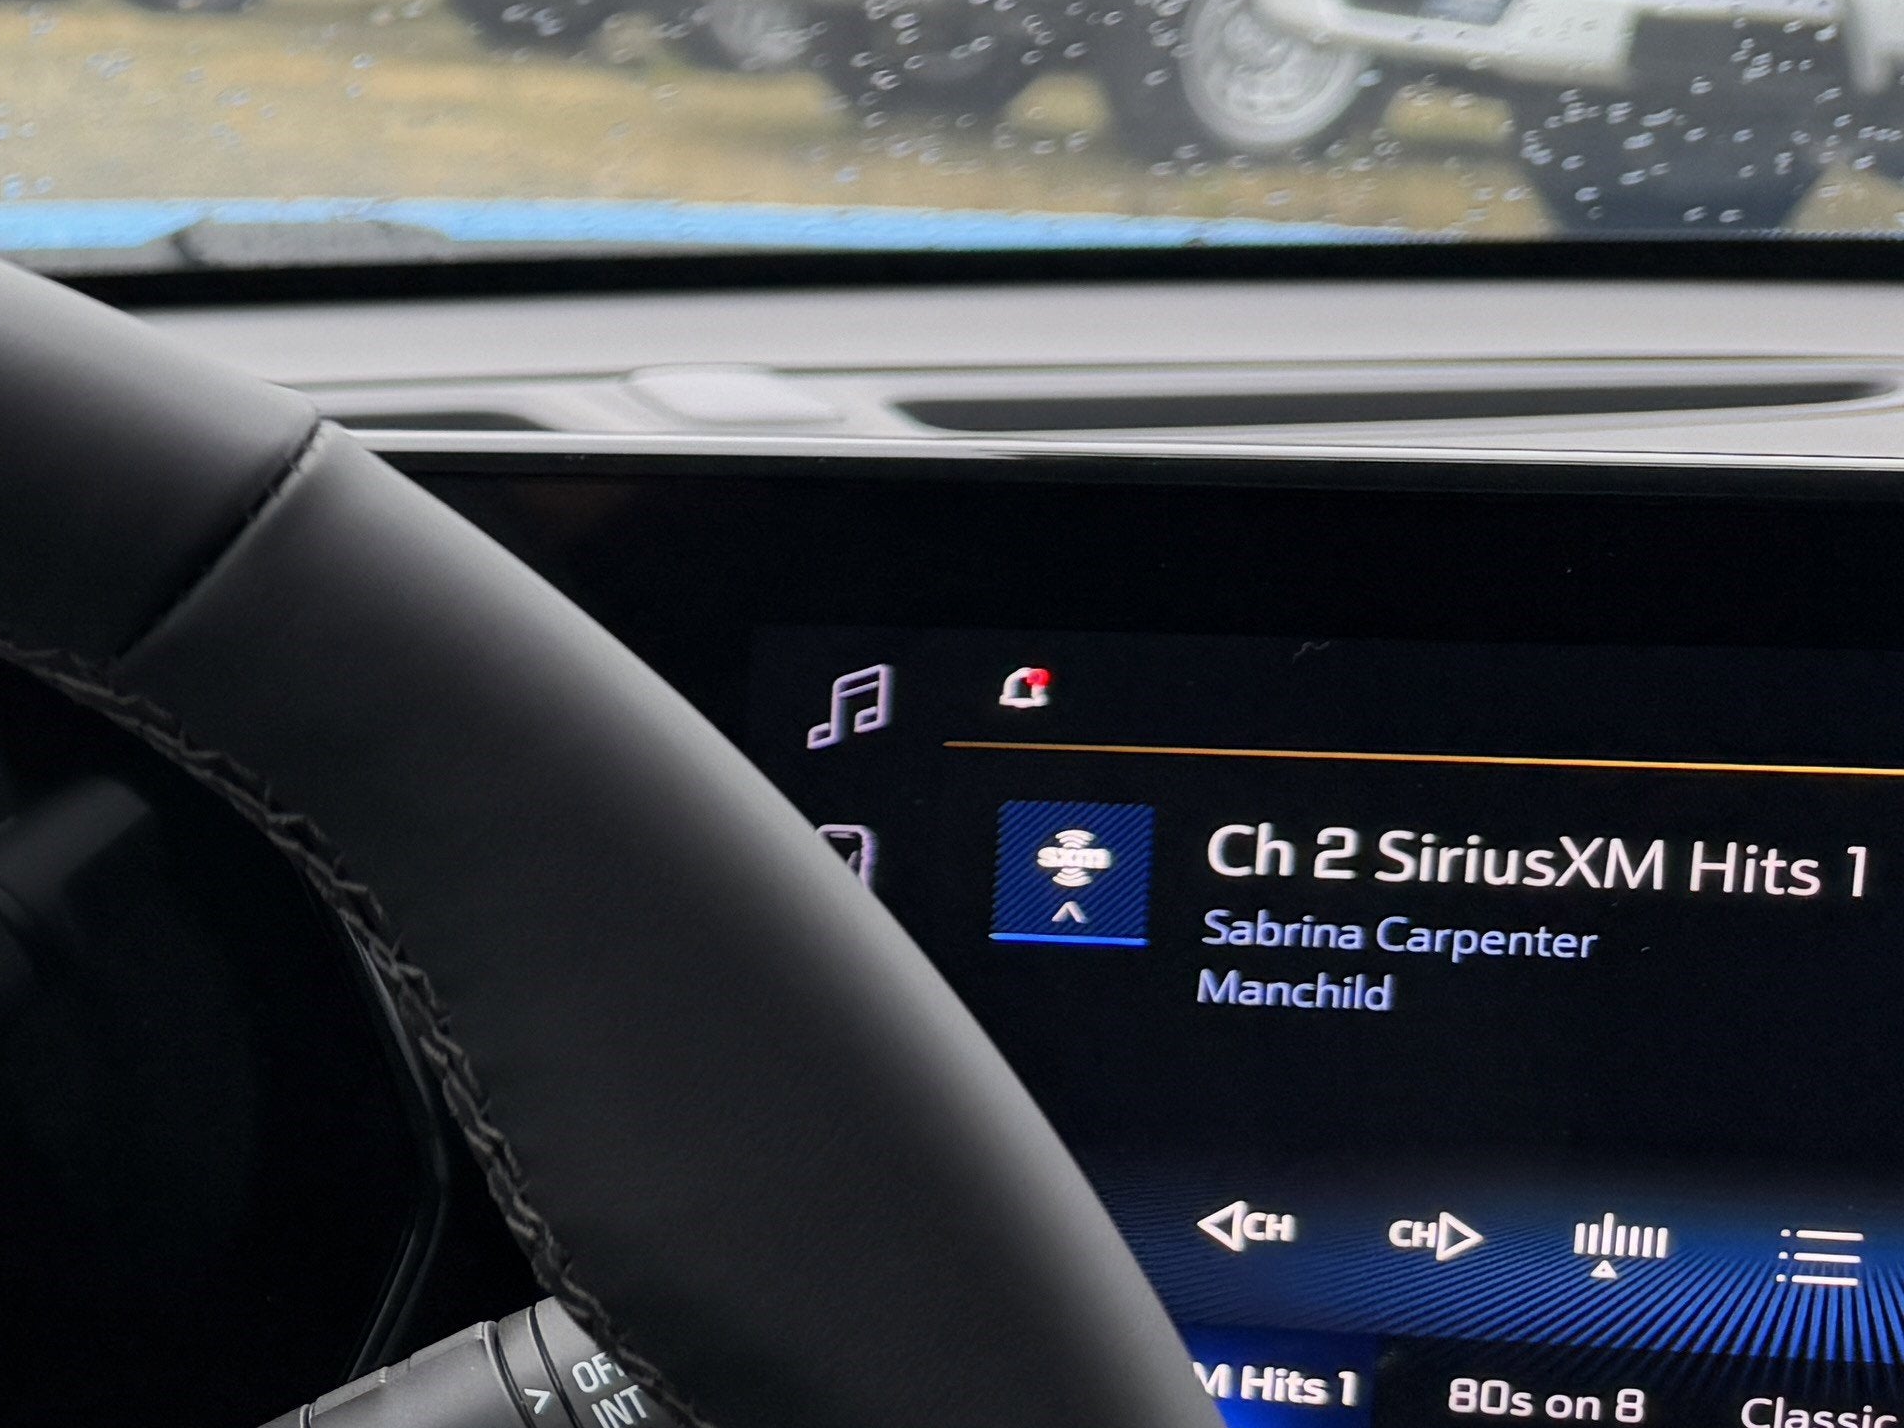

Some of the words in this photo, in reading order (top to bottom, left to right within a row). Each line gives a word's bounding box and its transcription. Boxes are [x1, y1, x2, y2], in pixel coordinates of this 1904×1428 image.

[1207, 822, 1293, 878] Ch
[1315, 826, 1357, 880] 2
[1375, 828, 1664, 891] SiriusXM
[1690, 841, 1822, 898] Hits
[1846, 845, 1868, 898] 1
[1202, 908, 1364, 951] Sabrina
[1376, 914, 1599, 964] Carpenter
[1197, 968, 1393, 1012] Manchild
[1243, 1212, 1295, 1243] CH
[1388, 1220, 1439, 1249] CH
[1240, 1365, 1330, 1406] Hits
[1338, 1370, 1360, 1407] 1
[1448, 1378, 1534, 1418] 80s
[1545, 1393, 1601, 1421] on
[1614, 1388, 1646, 1424] 8
